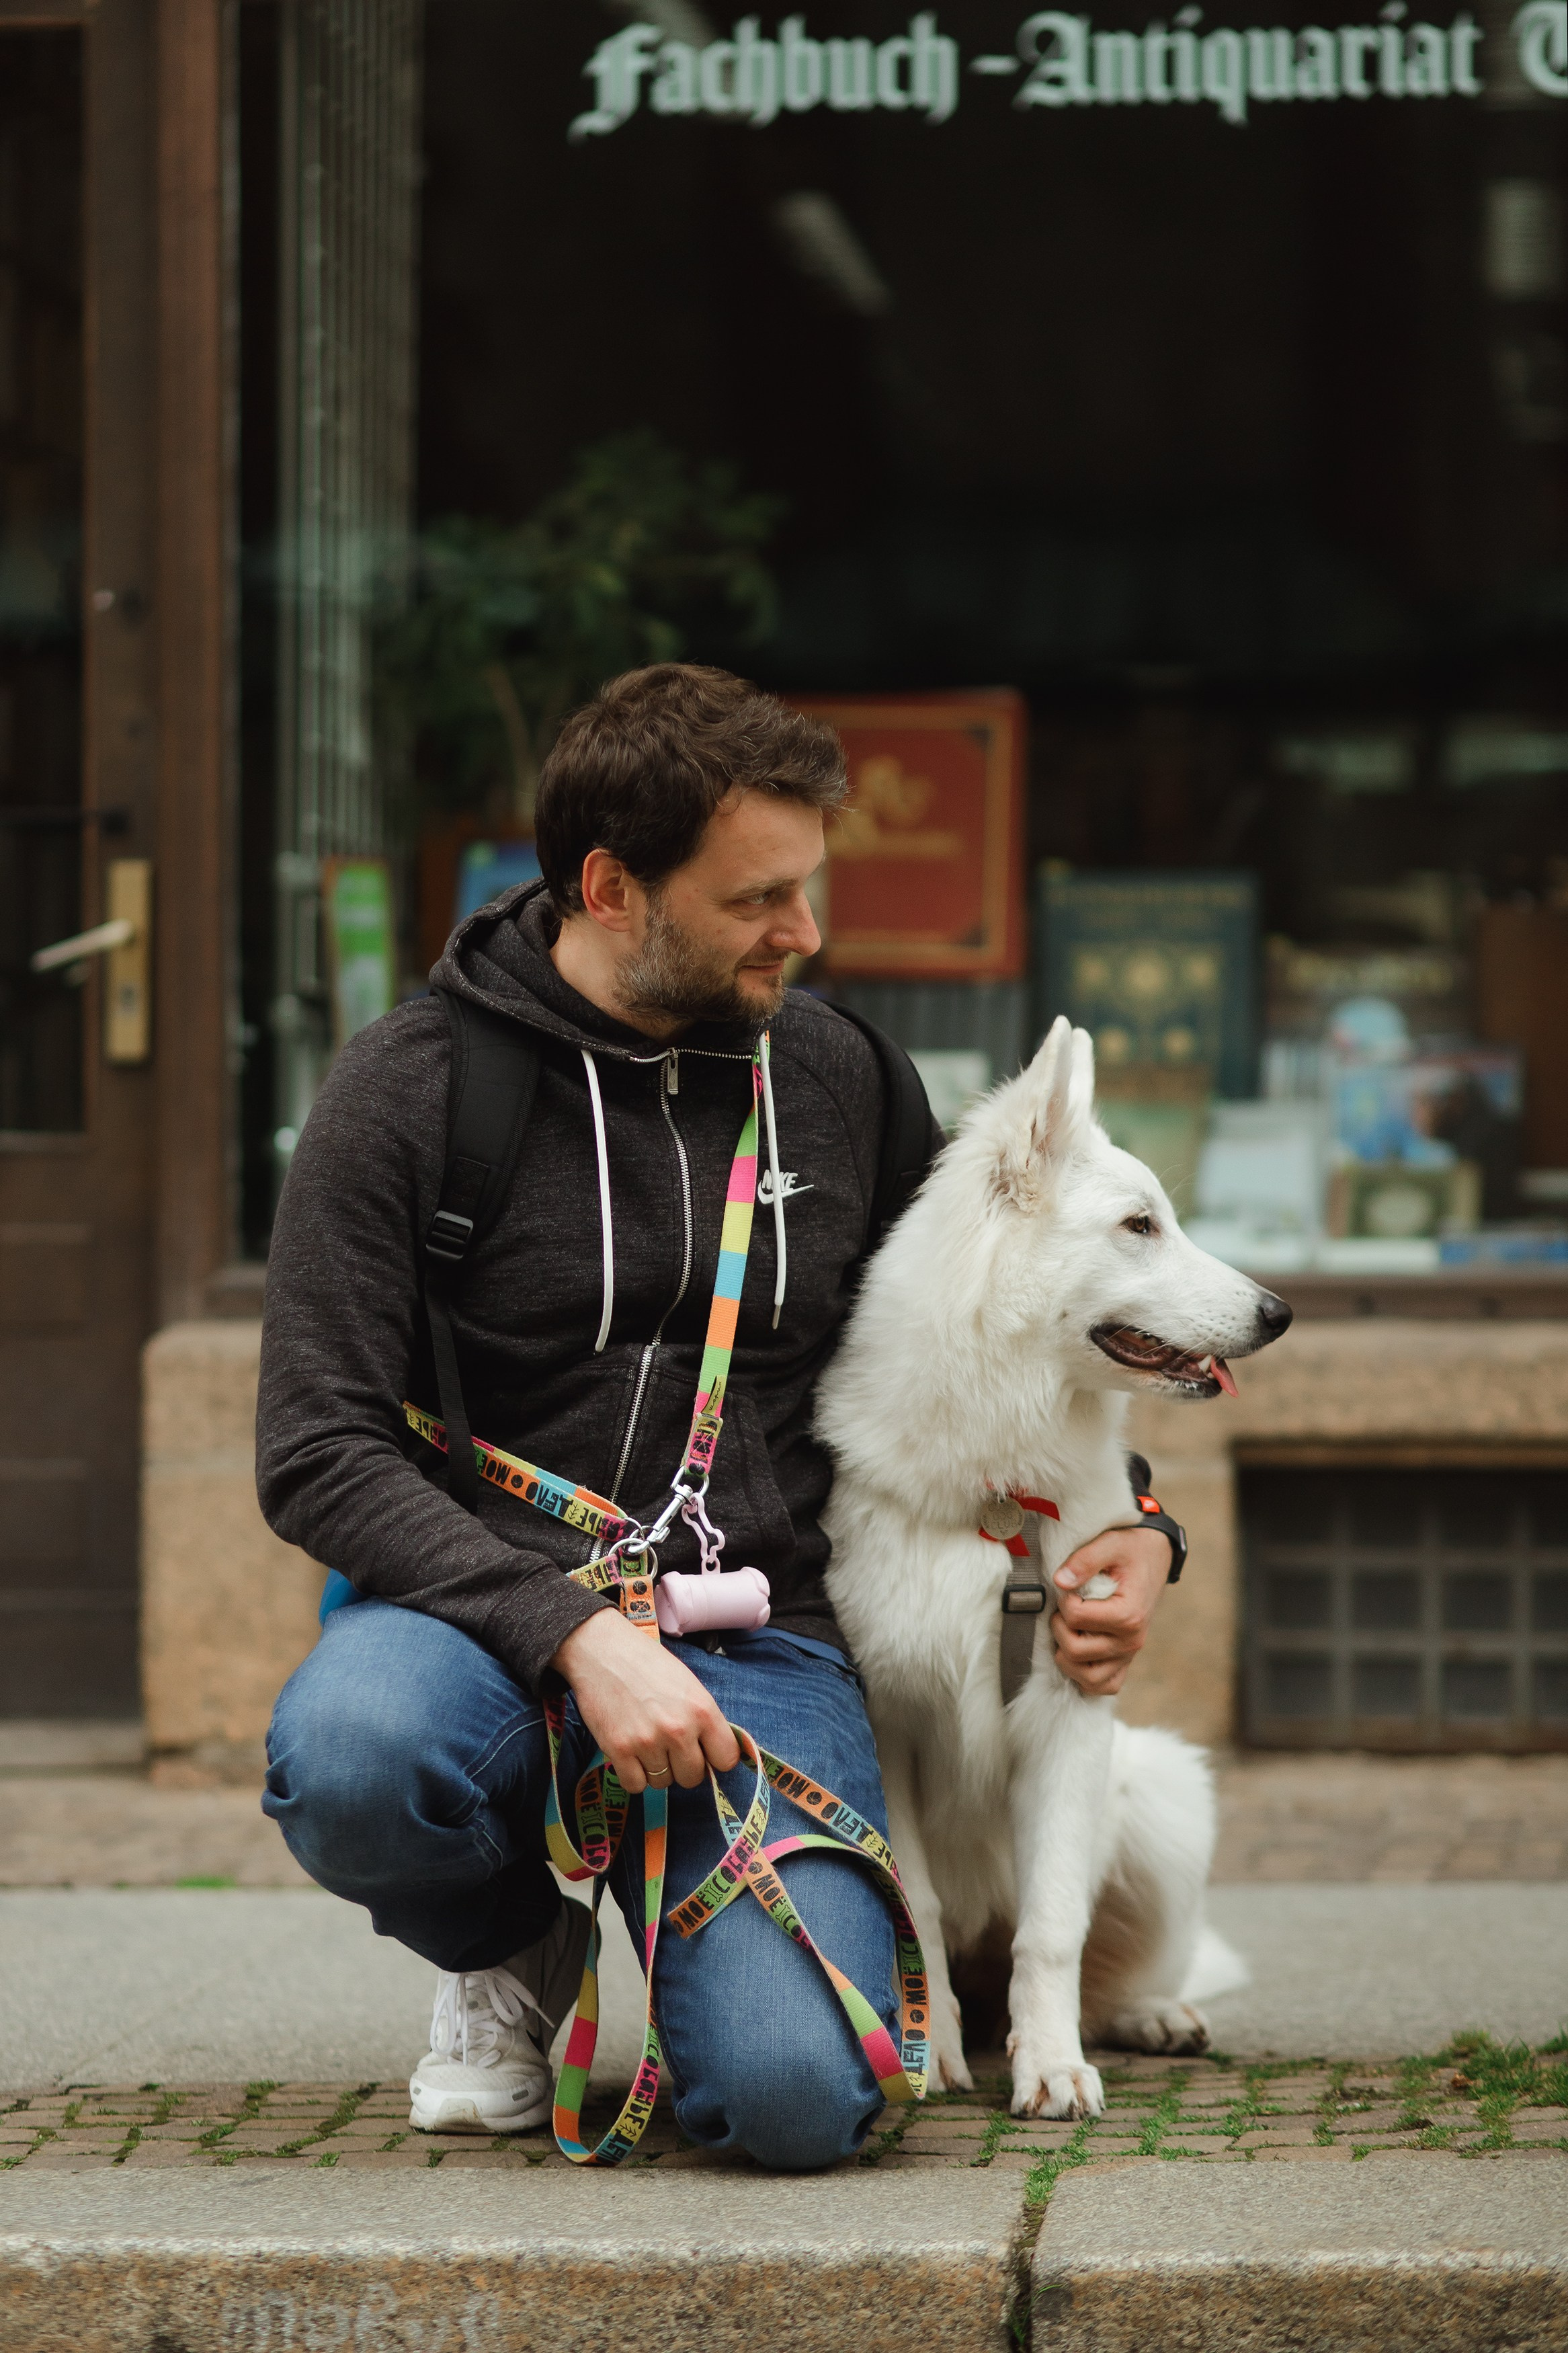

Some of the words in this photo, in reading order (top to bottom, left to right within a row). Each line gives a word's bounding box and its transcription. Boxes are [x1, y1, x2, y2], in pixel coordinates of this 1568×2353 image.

[761, 1169, 798, 1192] NKE
[677, 1890, 715, 1930] МОЁ
[752, 1874, 786, 1913] МОЁ
